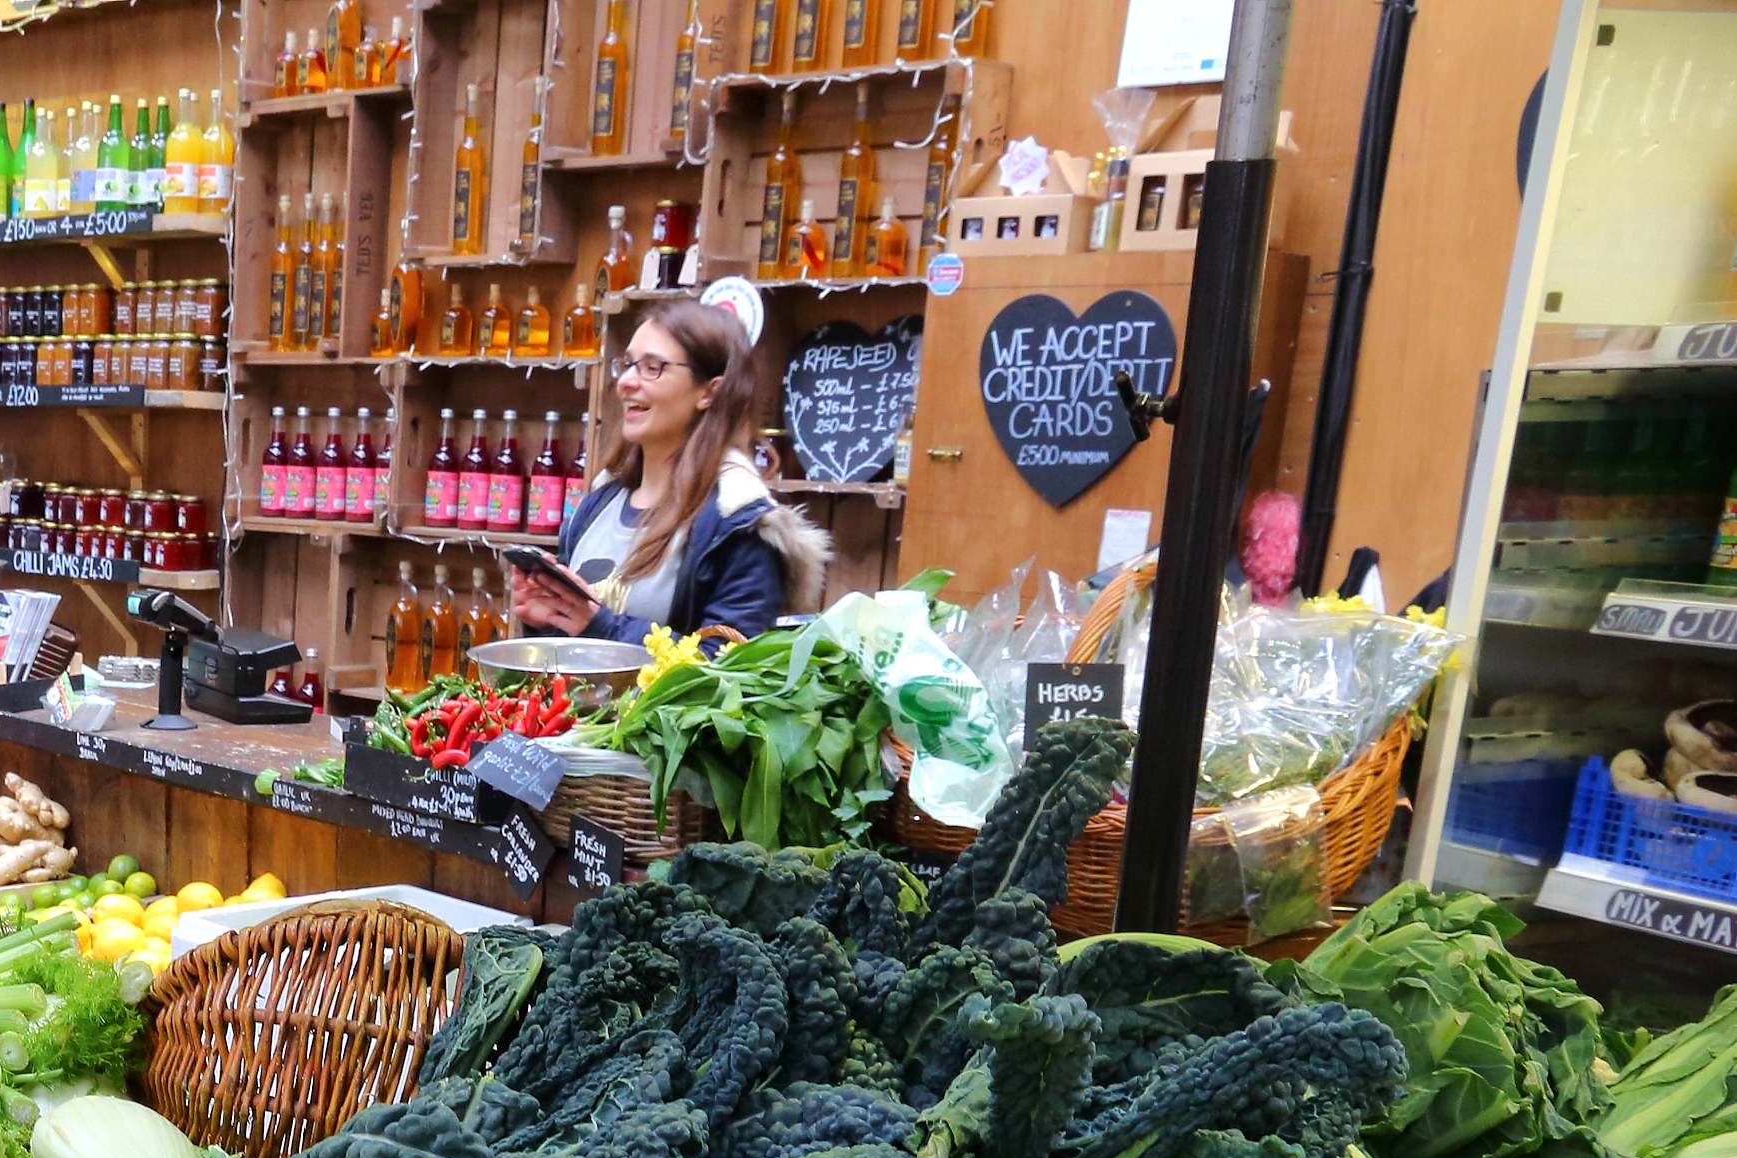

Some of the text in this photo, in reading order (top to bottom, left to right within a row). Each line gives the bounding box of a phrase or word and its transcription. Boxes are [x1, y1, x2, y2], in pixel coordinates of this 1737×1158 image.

[60, 216, 72, 235] 4
[990, 321, 1156, 366] WE ACCEPT
[1009, 401, 1114, 439] CARDS
[14, 551, 44, 574] CHILLI
[47, 553, 79, 578] JAMS
[1038, 682, 1105, 704] HERBS
[474, 750, 514, 773] garlic
[522, 745, 558, 771] Wild
[511, 814, 536, 851] FRESH
[575, 829, 606, 858] FRESH
[501, 824, 540, 883] CORIANDER
[574, 847, 605, 871] MINT
[1609, 891, 1661, 927] MIX
[1687, 910, 1737, 946] MA
